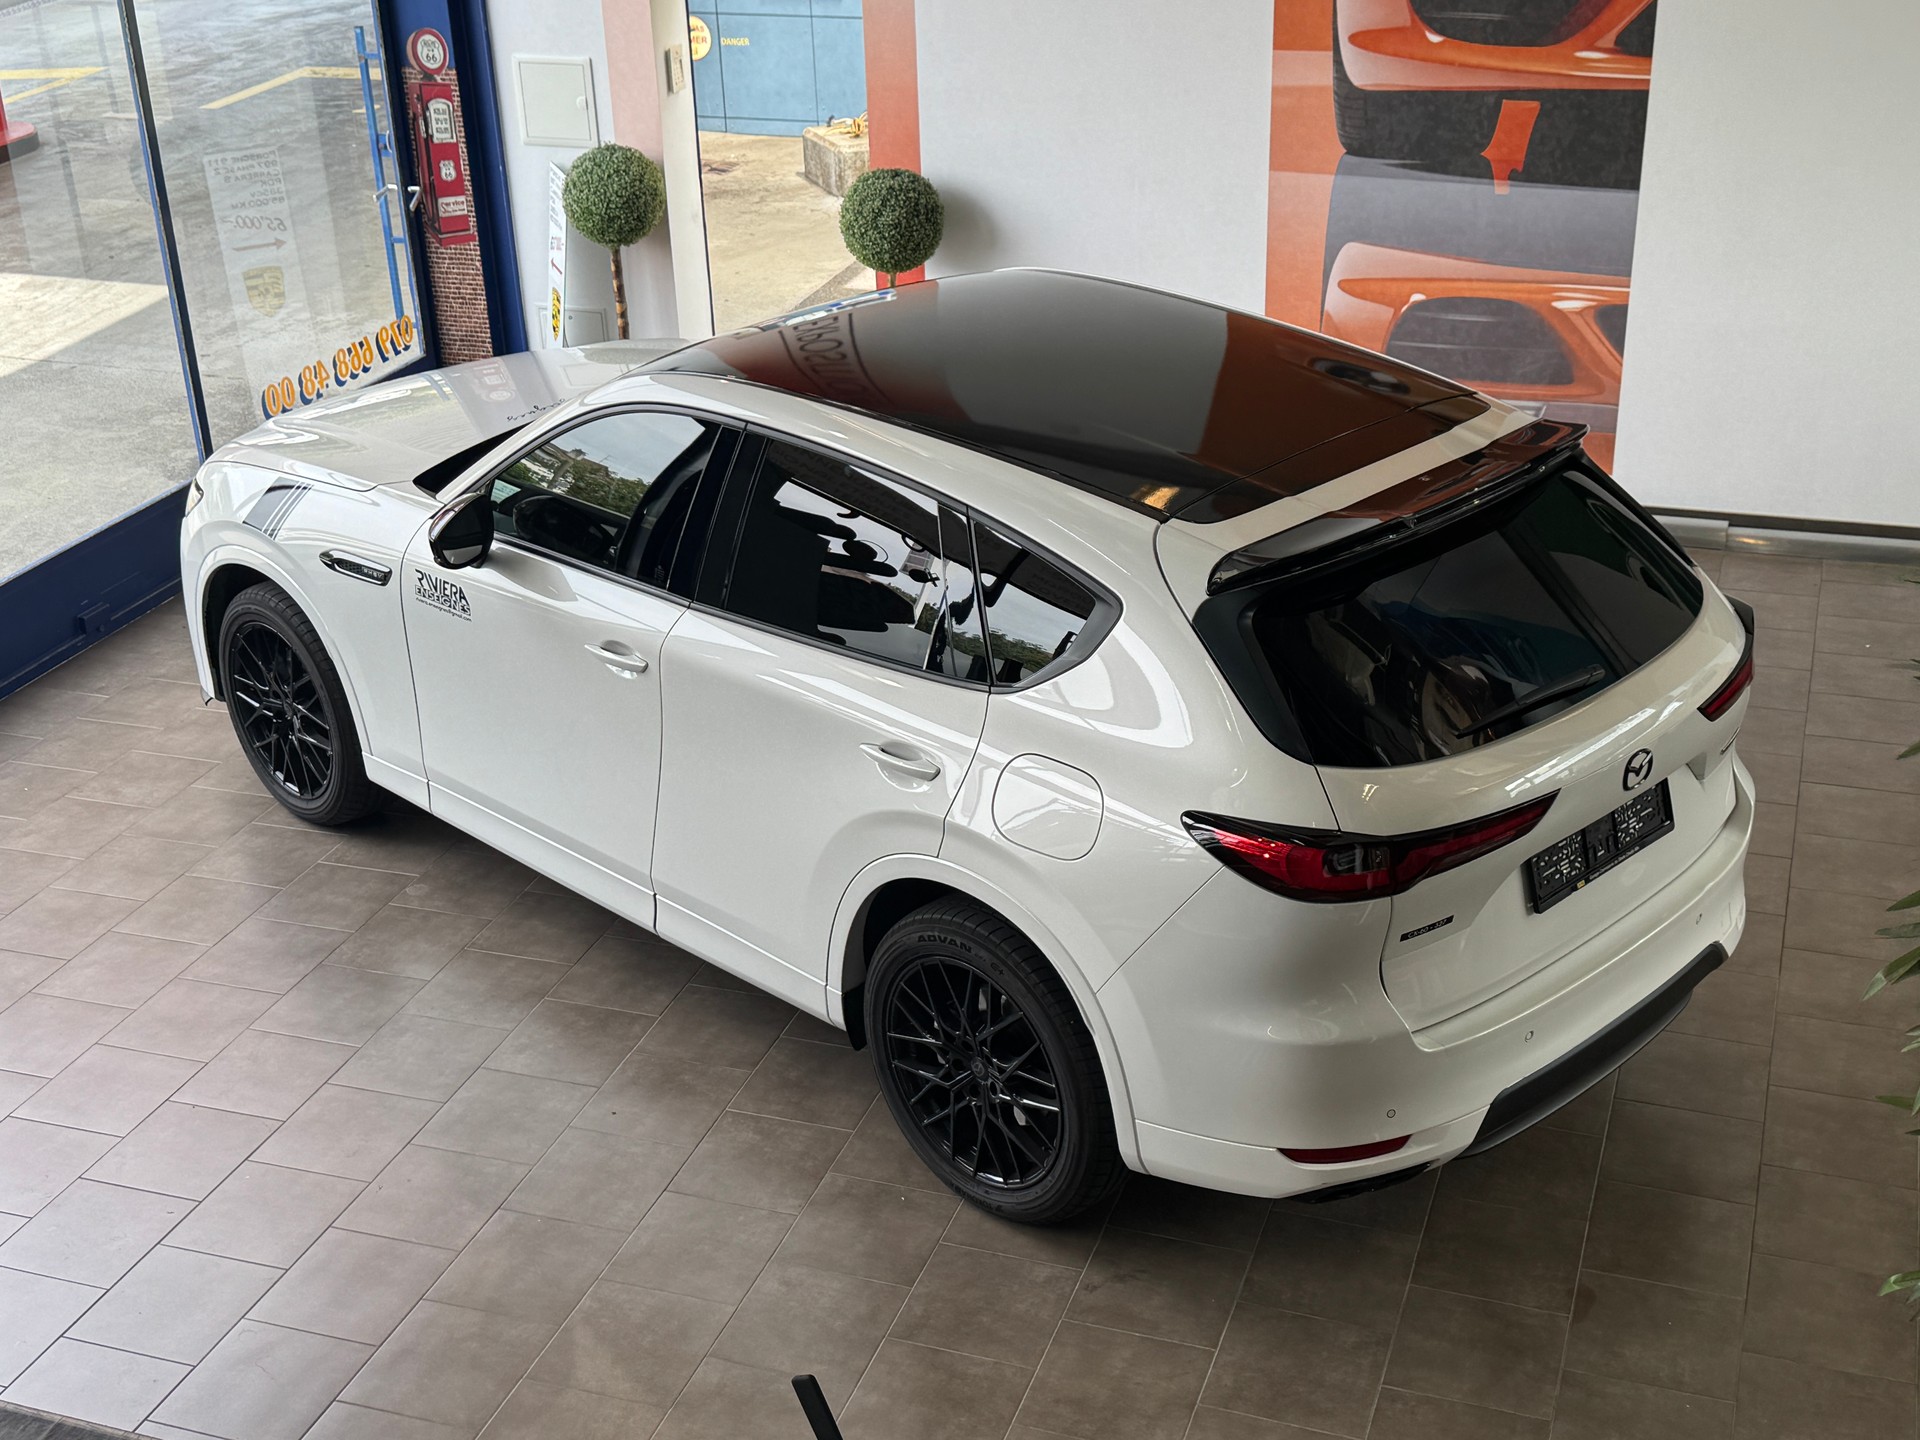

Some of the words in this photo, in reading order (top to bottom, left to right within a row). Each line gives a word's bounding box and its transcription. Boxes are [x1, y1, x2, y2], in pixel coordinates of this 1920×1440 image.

[721, 37, 750, 46] DANGER
[425, 52, 438, 62] 66
[415, 568, 471, 608] RIVIERA
[415, 584, 471, 617] ENSEIGNES
[918, 934, 972, 953] ADVAN
